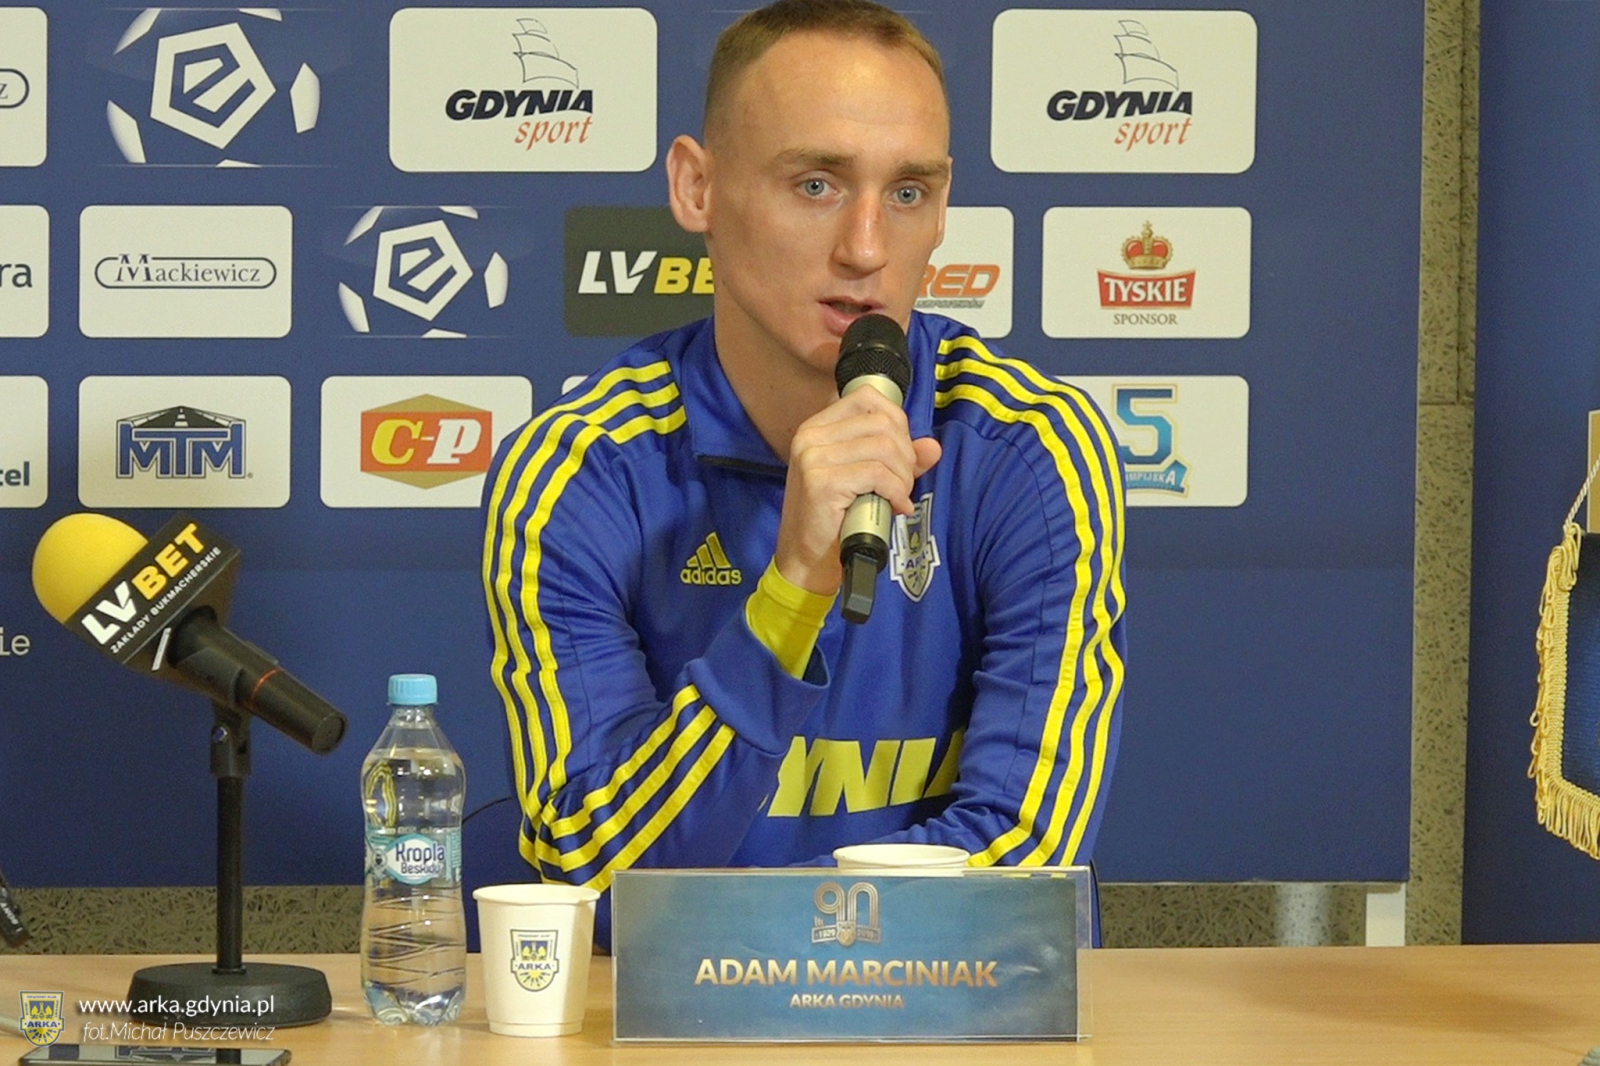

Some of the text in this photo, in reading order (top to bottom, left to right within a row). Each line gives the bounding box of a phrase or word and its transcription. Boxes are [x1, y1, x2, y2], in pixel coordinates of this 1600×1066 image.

[445, 89, 593, 121] GDYNIA
[1046, 90, 1193, 121] GDYNIA
[514, 115, 594, 151] sport
[1114, 117, 1193, 152] sport
[114, 253, 261, 282] Mackiewicz
[1104, 277, 1188, 303] TYSKIE
[1113, 313, 1178, 326] SPONSOR
[1115, 388, 1174, 466] 5
[116, 419, 246, 479] MTM
[680, 566, 742, 585] adidas
[110, 546, 222, 654] ZAKŁADY BUKMACHERSKIE
[395, 843, 445, 863] Kropla
[694, 958, 998, 987] ADAM MARCINIAK
[789, 994, 905, 1008] ARKA GDYNIA
